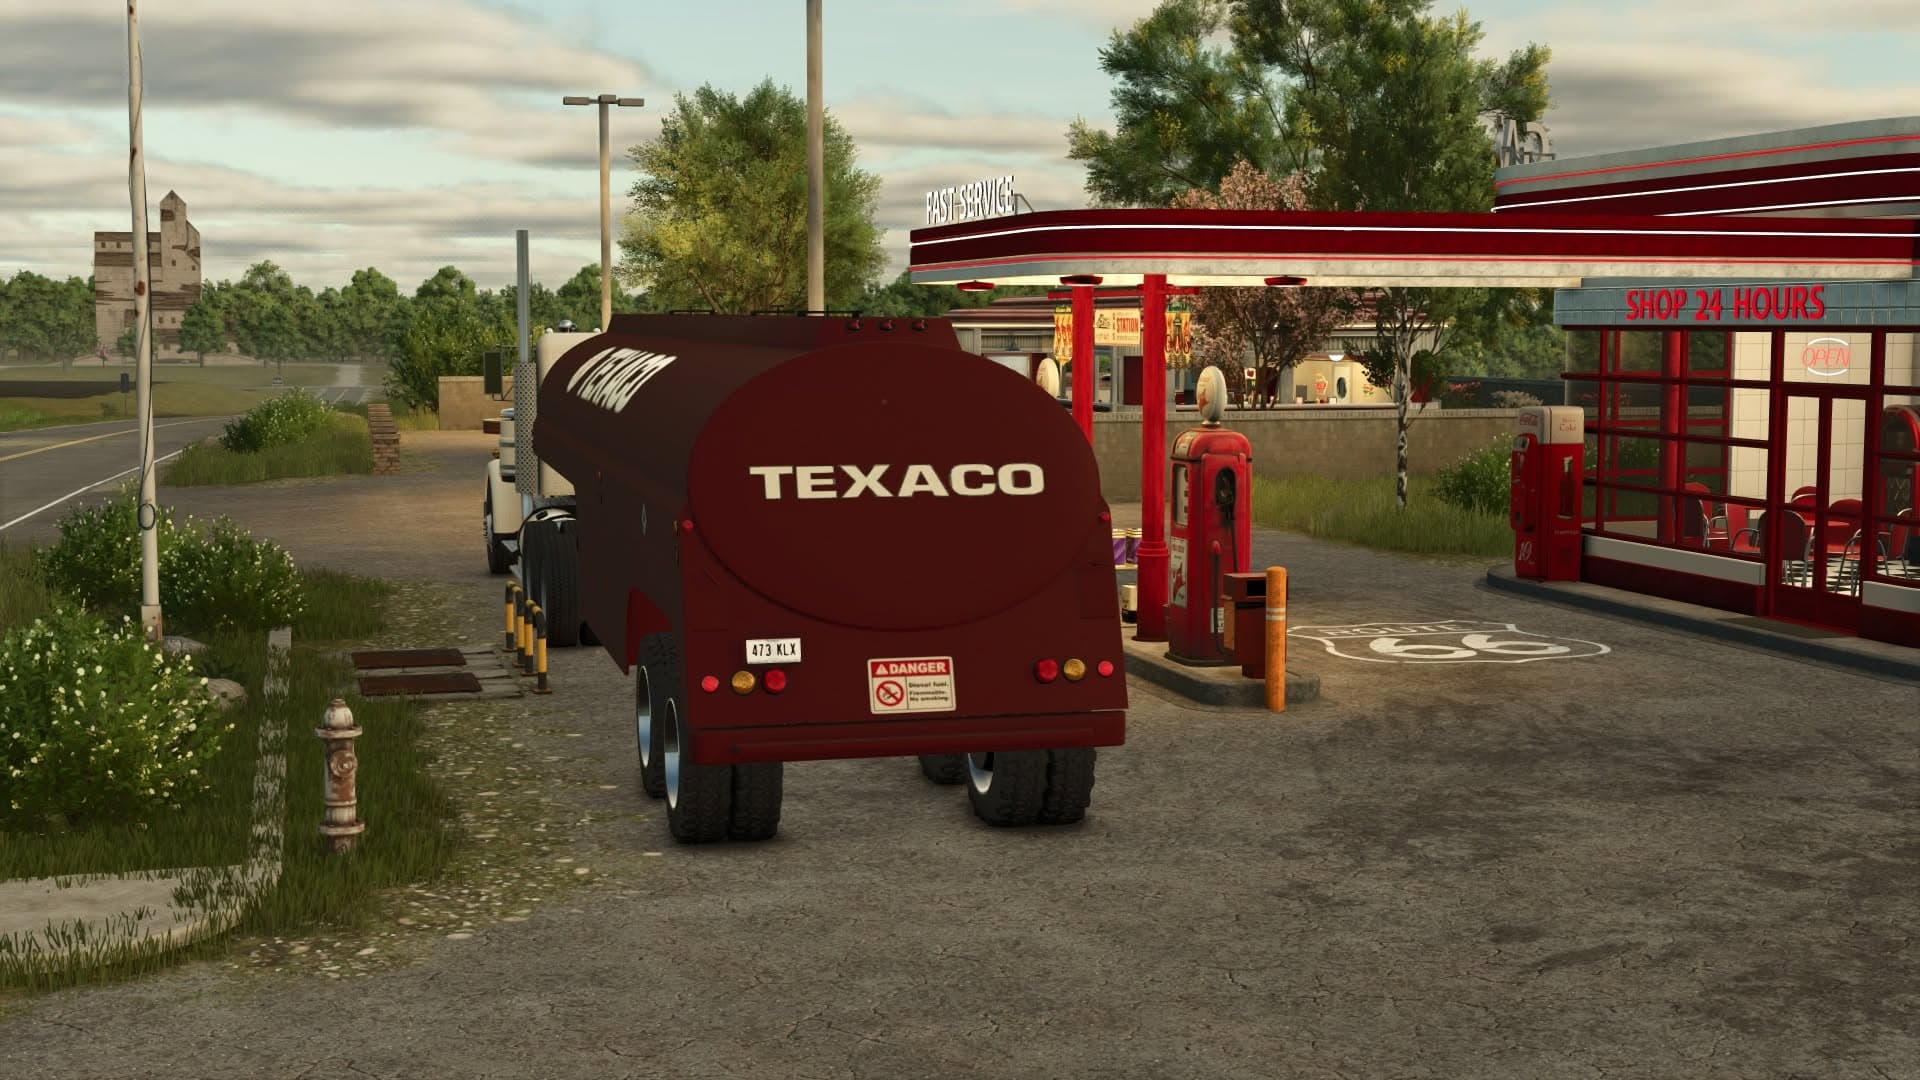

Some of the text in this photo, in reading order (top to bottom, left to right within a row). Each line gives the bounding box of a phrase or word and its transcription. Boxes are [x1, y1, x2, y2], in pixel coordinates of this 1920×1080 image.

[926, 175, 1015, 225] FAST SERVICE
[1626, 284, 1825, 320] SHOP 24 HOURS
[1802, 347, 1851, 368] OPEN
[749, 463, 1045, 499] TEXACO
[1318, 622, 1474, 636] ROUTE
[752, 642, 796, 657] 473 KLX
[1369, 634, 1571, 659] 66
[889, 662, 947, 674] DANGER
